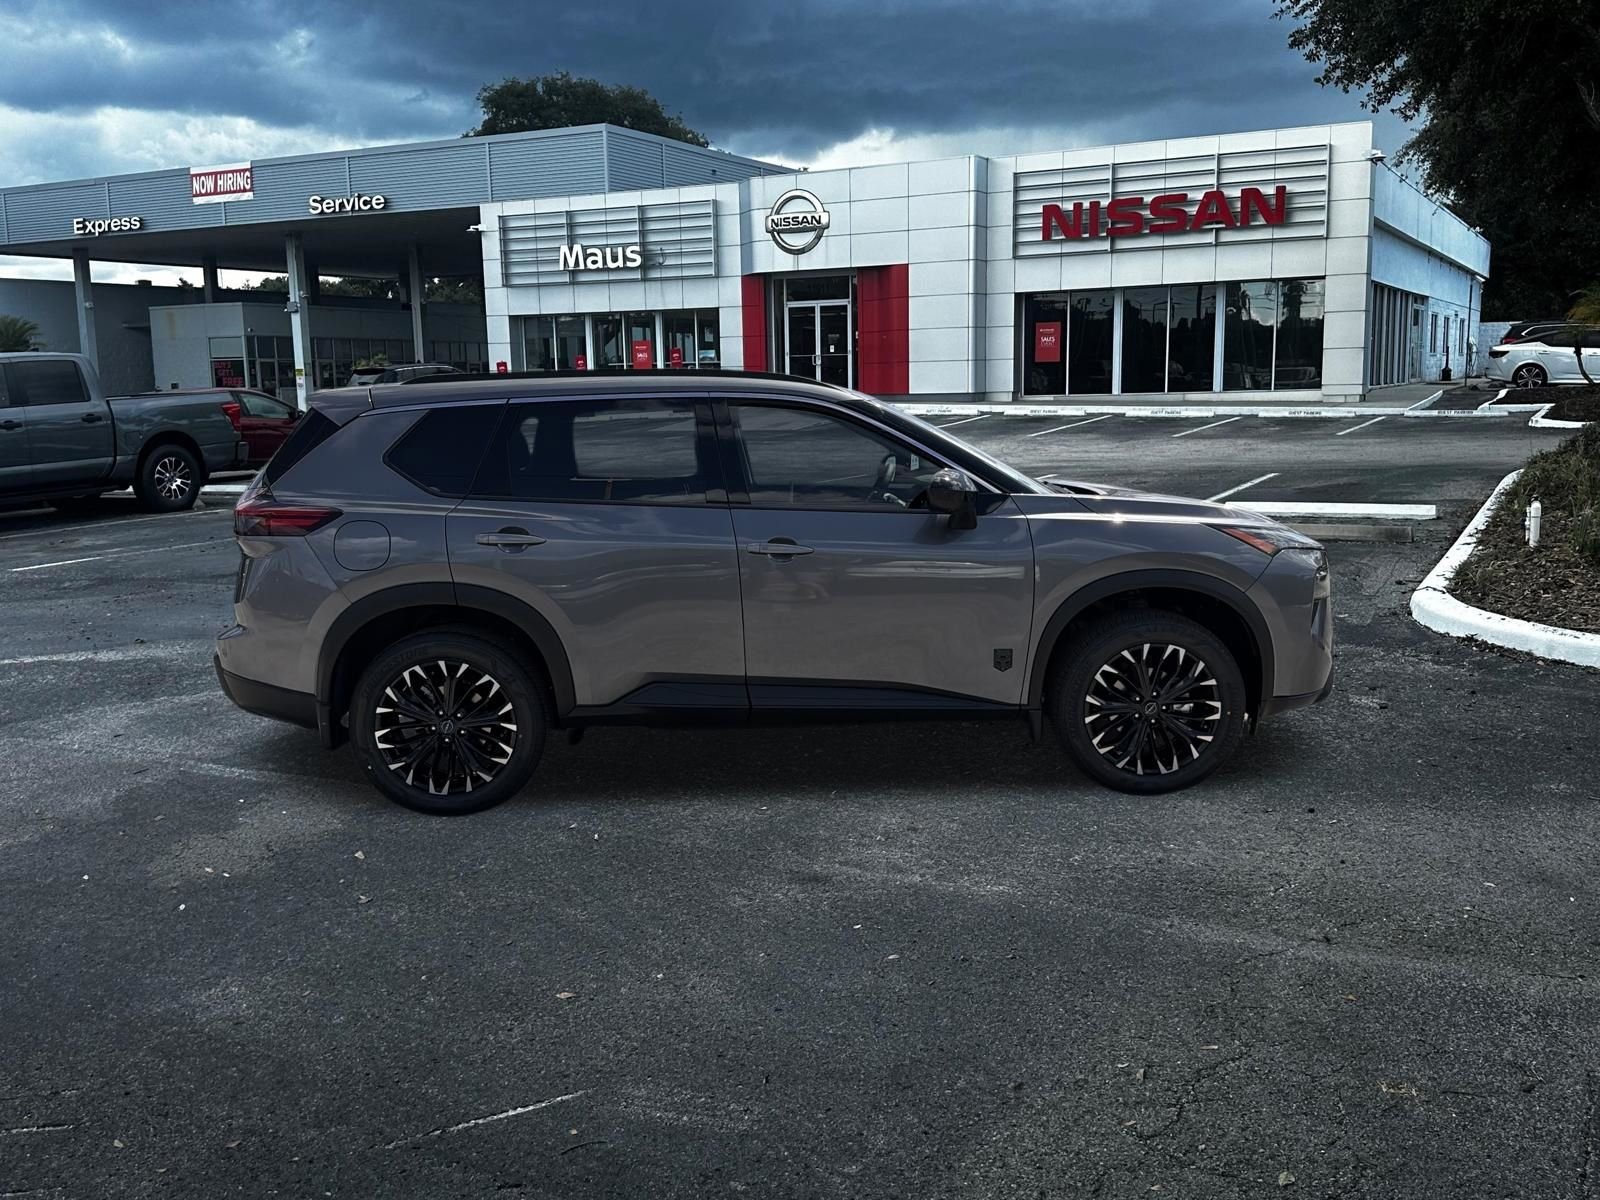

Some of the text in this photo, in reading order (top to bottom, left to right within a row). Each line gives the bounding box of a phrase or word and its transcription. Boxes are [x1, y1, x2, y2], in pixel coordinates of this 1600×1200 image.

[192, 171, 251, 195] NOW HIRING
[308, 194, 386, 215] Service
[1041, 185, 1287, 241] NISSAN
[73, 216, 141, 236] Express
[770, 214, 822, 228] NISSAN
[559, 244, 642, 271] Maus
